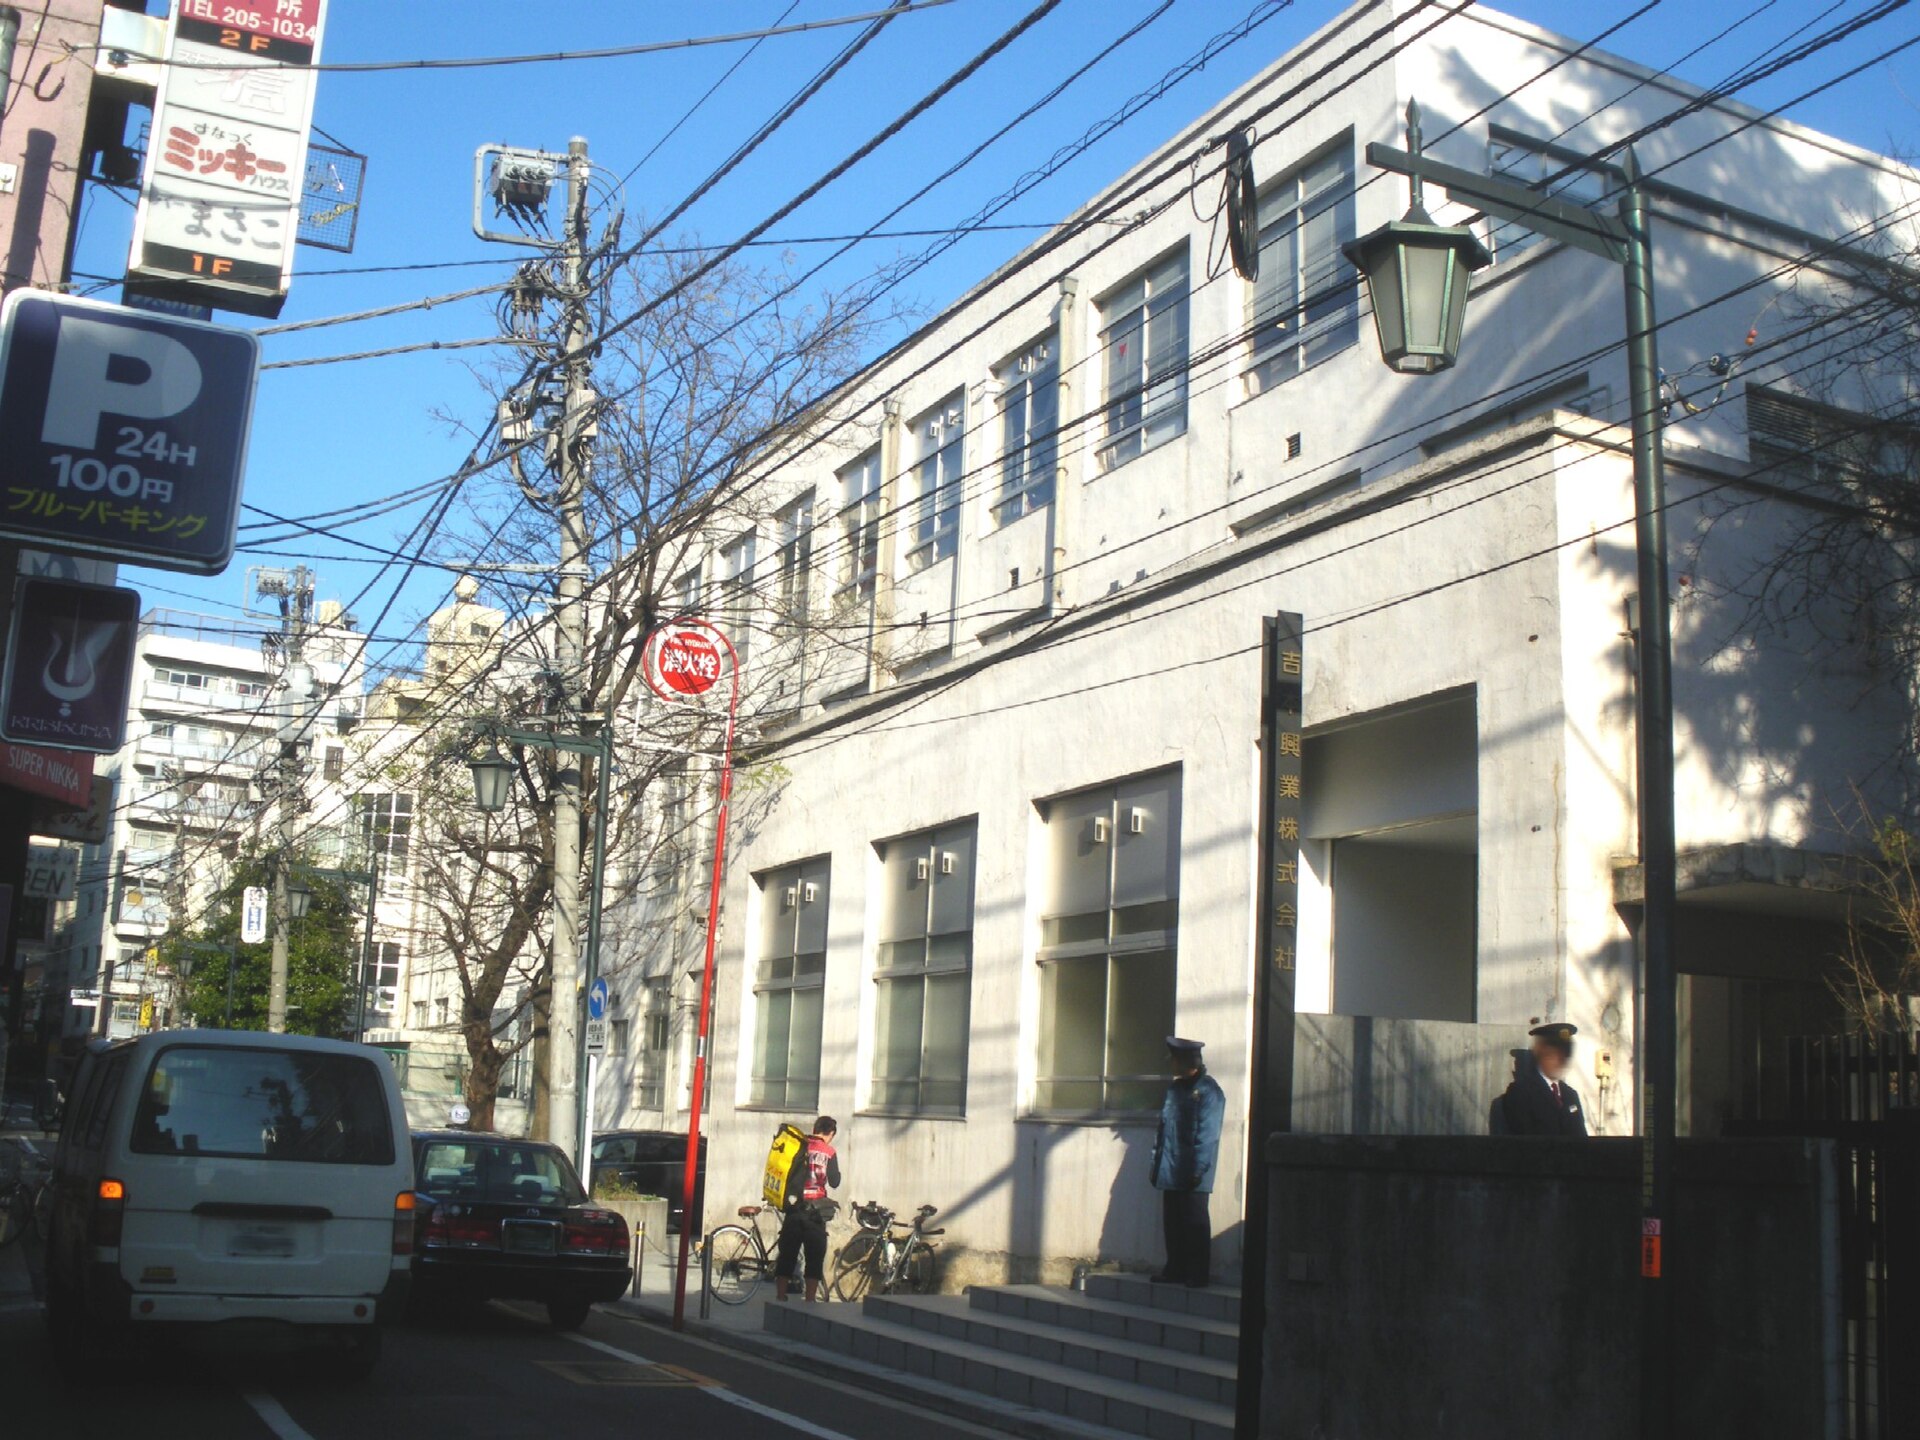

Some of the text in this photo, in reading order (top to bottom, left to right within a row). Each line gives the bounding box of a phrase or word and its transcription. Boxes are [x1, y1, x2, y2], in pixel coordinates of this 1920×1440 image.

[222, 6, 317, 41] 205-1034
[164, 126, 287, 183] ミッキー
[193, 123, 253, 146] すなっく
[250, 174, 290, 192] ハウス
[184, 203, 282, 250] まさこ
[41, 315, 202, 450] P
[115, 426, 197, 466] 24H
[50, 453, 174, 503] 100円
[8, 486, 208, 538] ブルーパーキング
[663, 646, 717, 679] 消火栓
[8, 746, 81, 792] SUPER NIKKA
